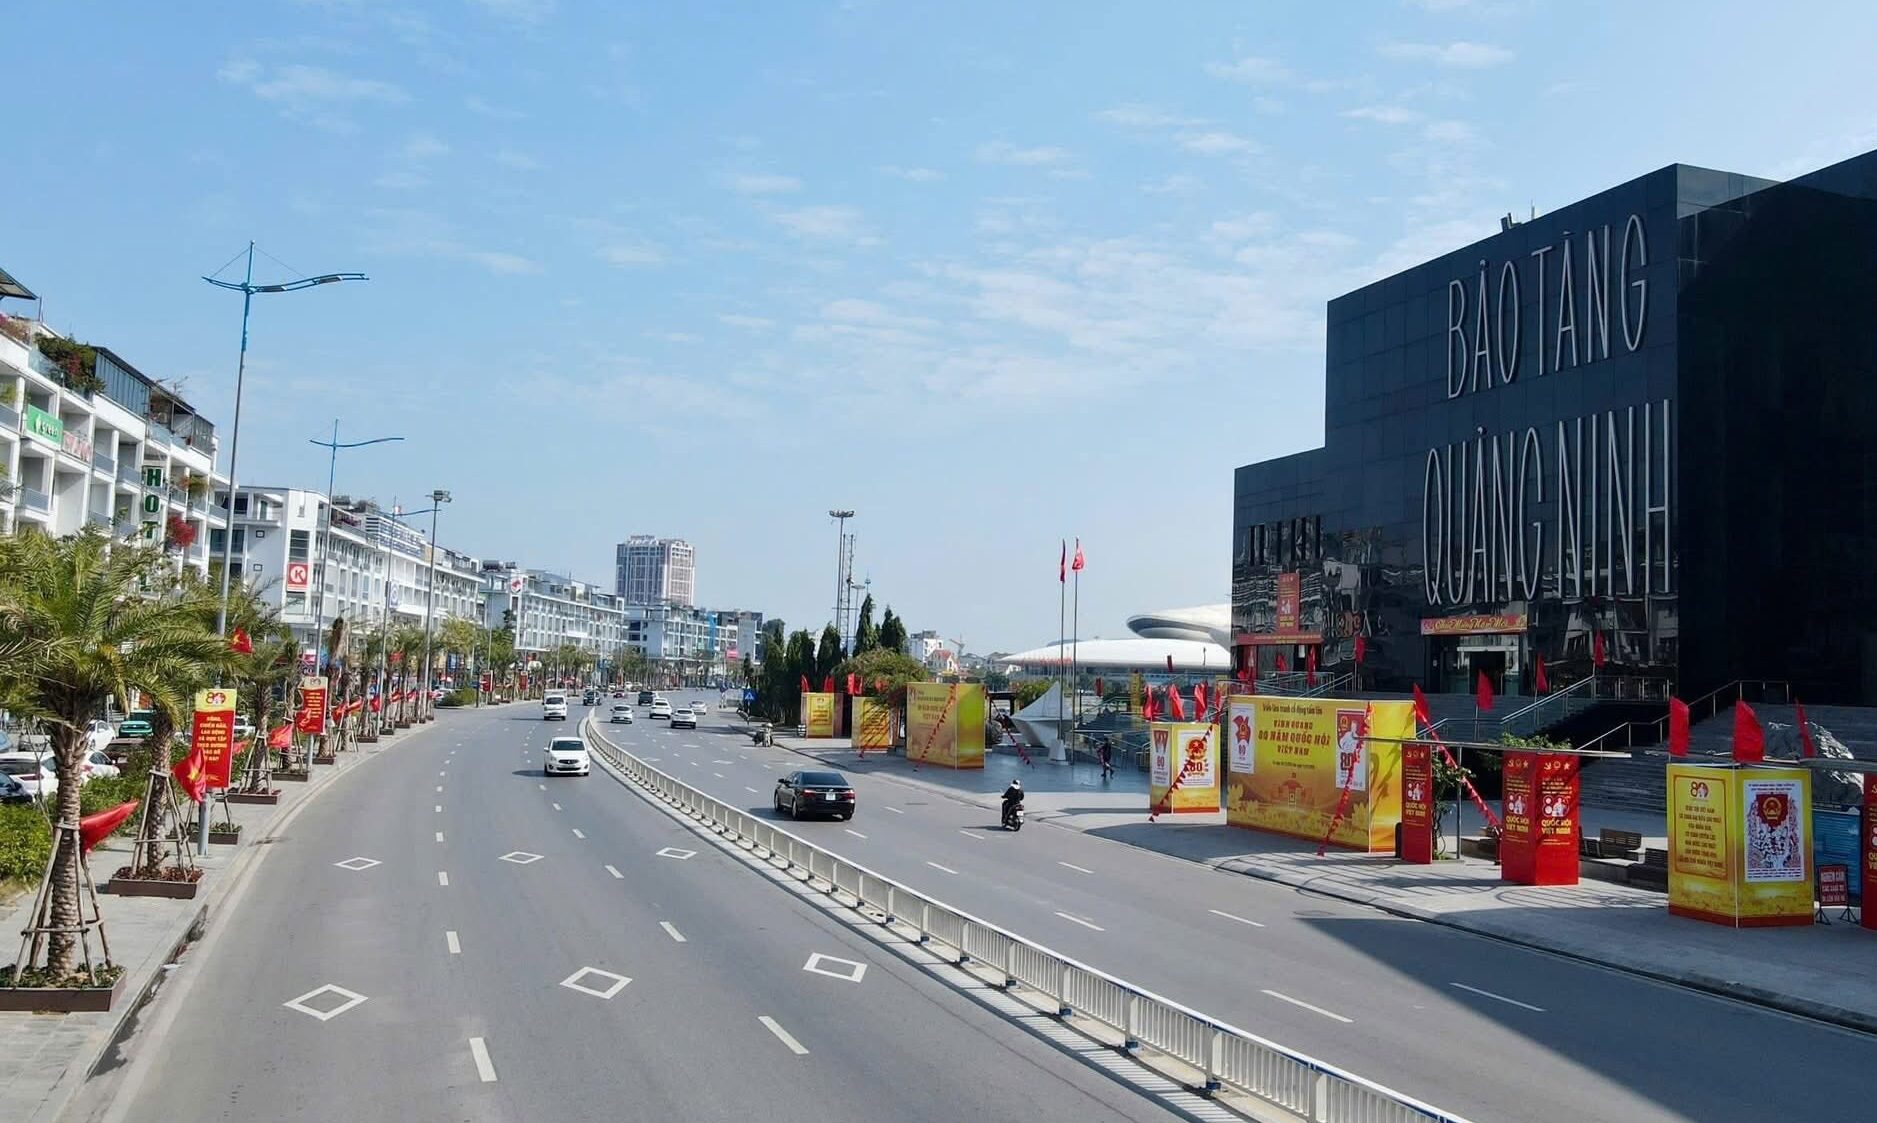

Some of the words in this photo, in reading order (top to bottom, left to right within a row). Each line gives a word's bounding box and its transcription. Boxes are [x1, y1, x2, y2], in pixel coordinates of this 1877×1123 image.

[1448, 260, 1518, 398] BẢO
[1531, 215, 1647, 378] TÀNG
[1424, 427, 1542, 605] QUẢNG
[1559, 400, 1669, 599] NINH
